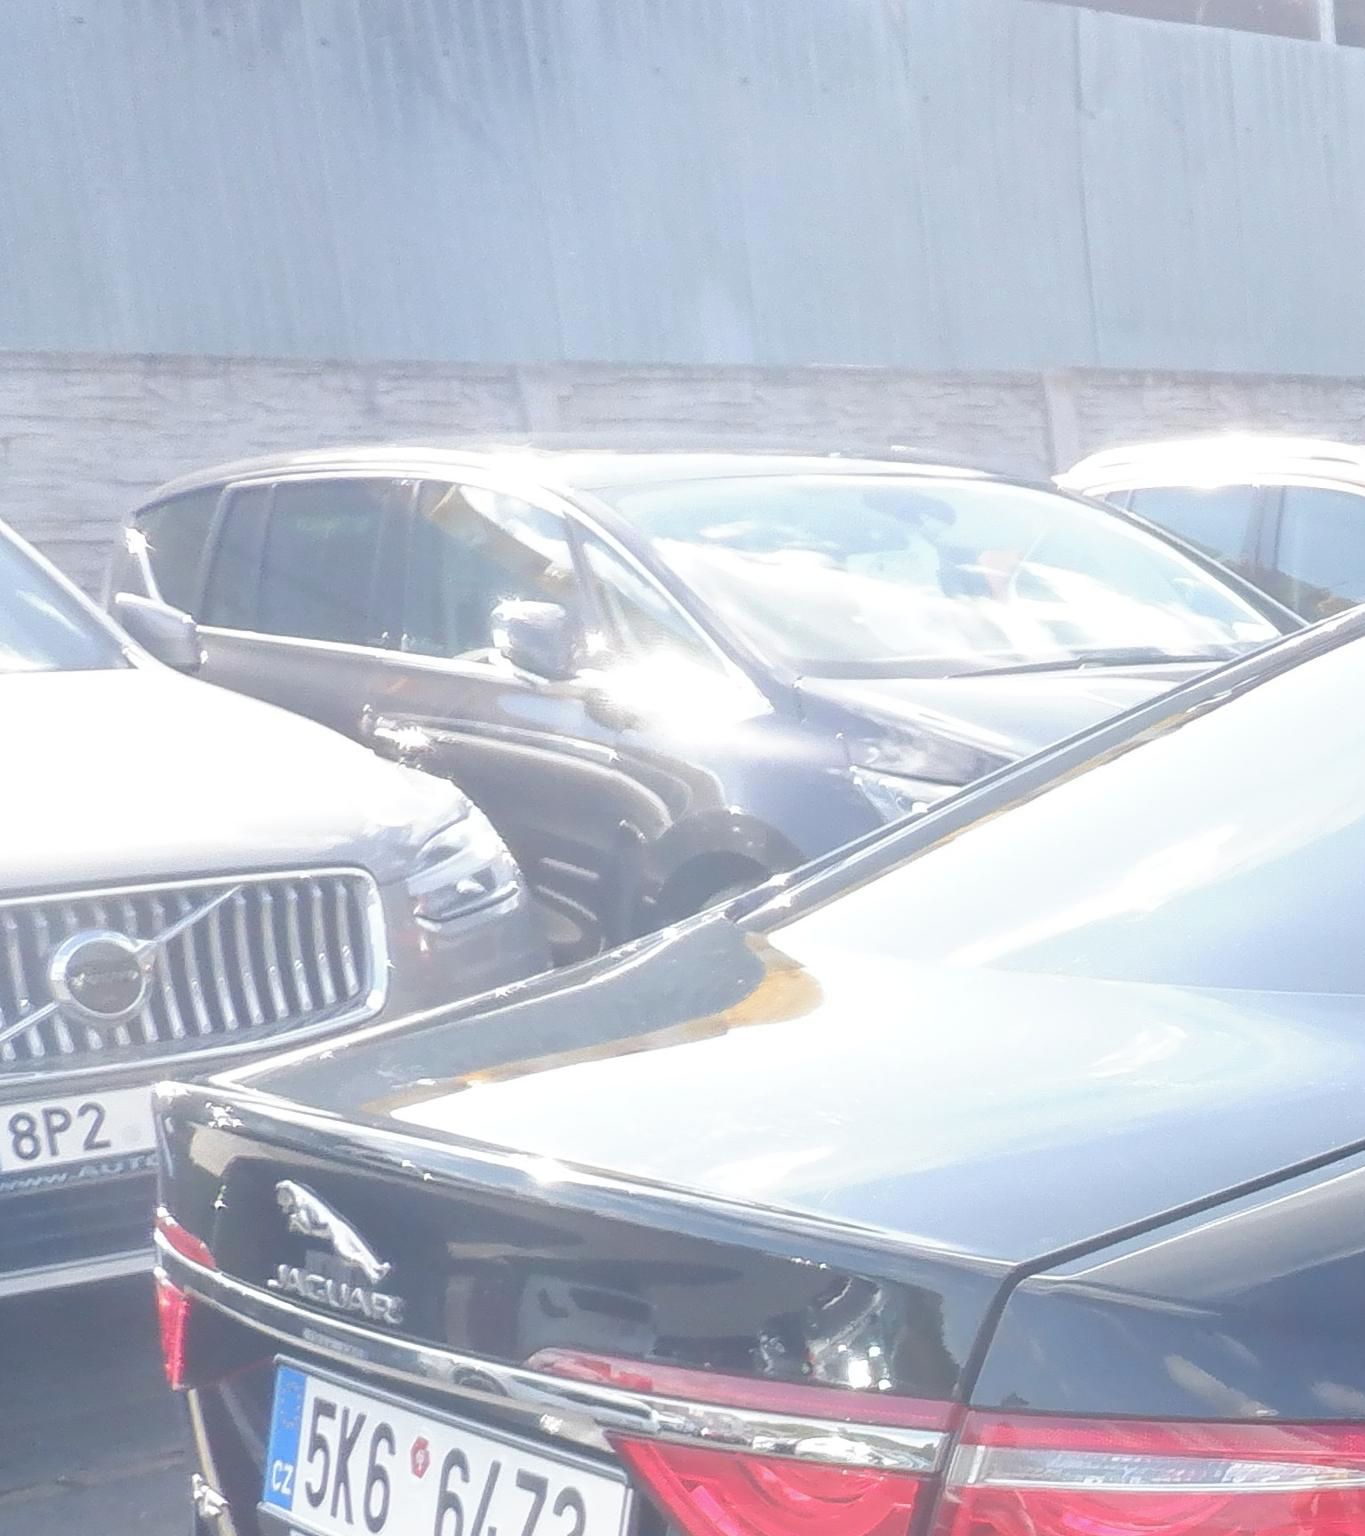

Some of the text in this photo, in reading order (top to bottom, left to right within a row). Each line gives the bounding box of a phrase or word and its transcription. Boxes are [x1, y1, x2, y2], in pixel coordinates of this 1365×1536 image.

[8, 1102, 112, 1160] 8P2
[266, 1263, 405, 1325] JAGUAR
[271, 1459, 293, 1496] CZ
[305, 1397, 397, 1534] 5K6
